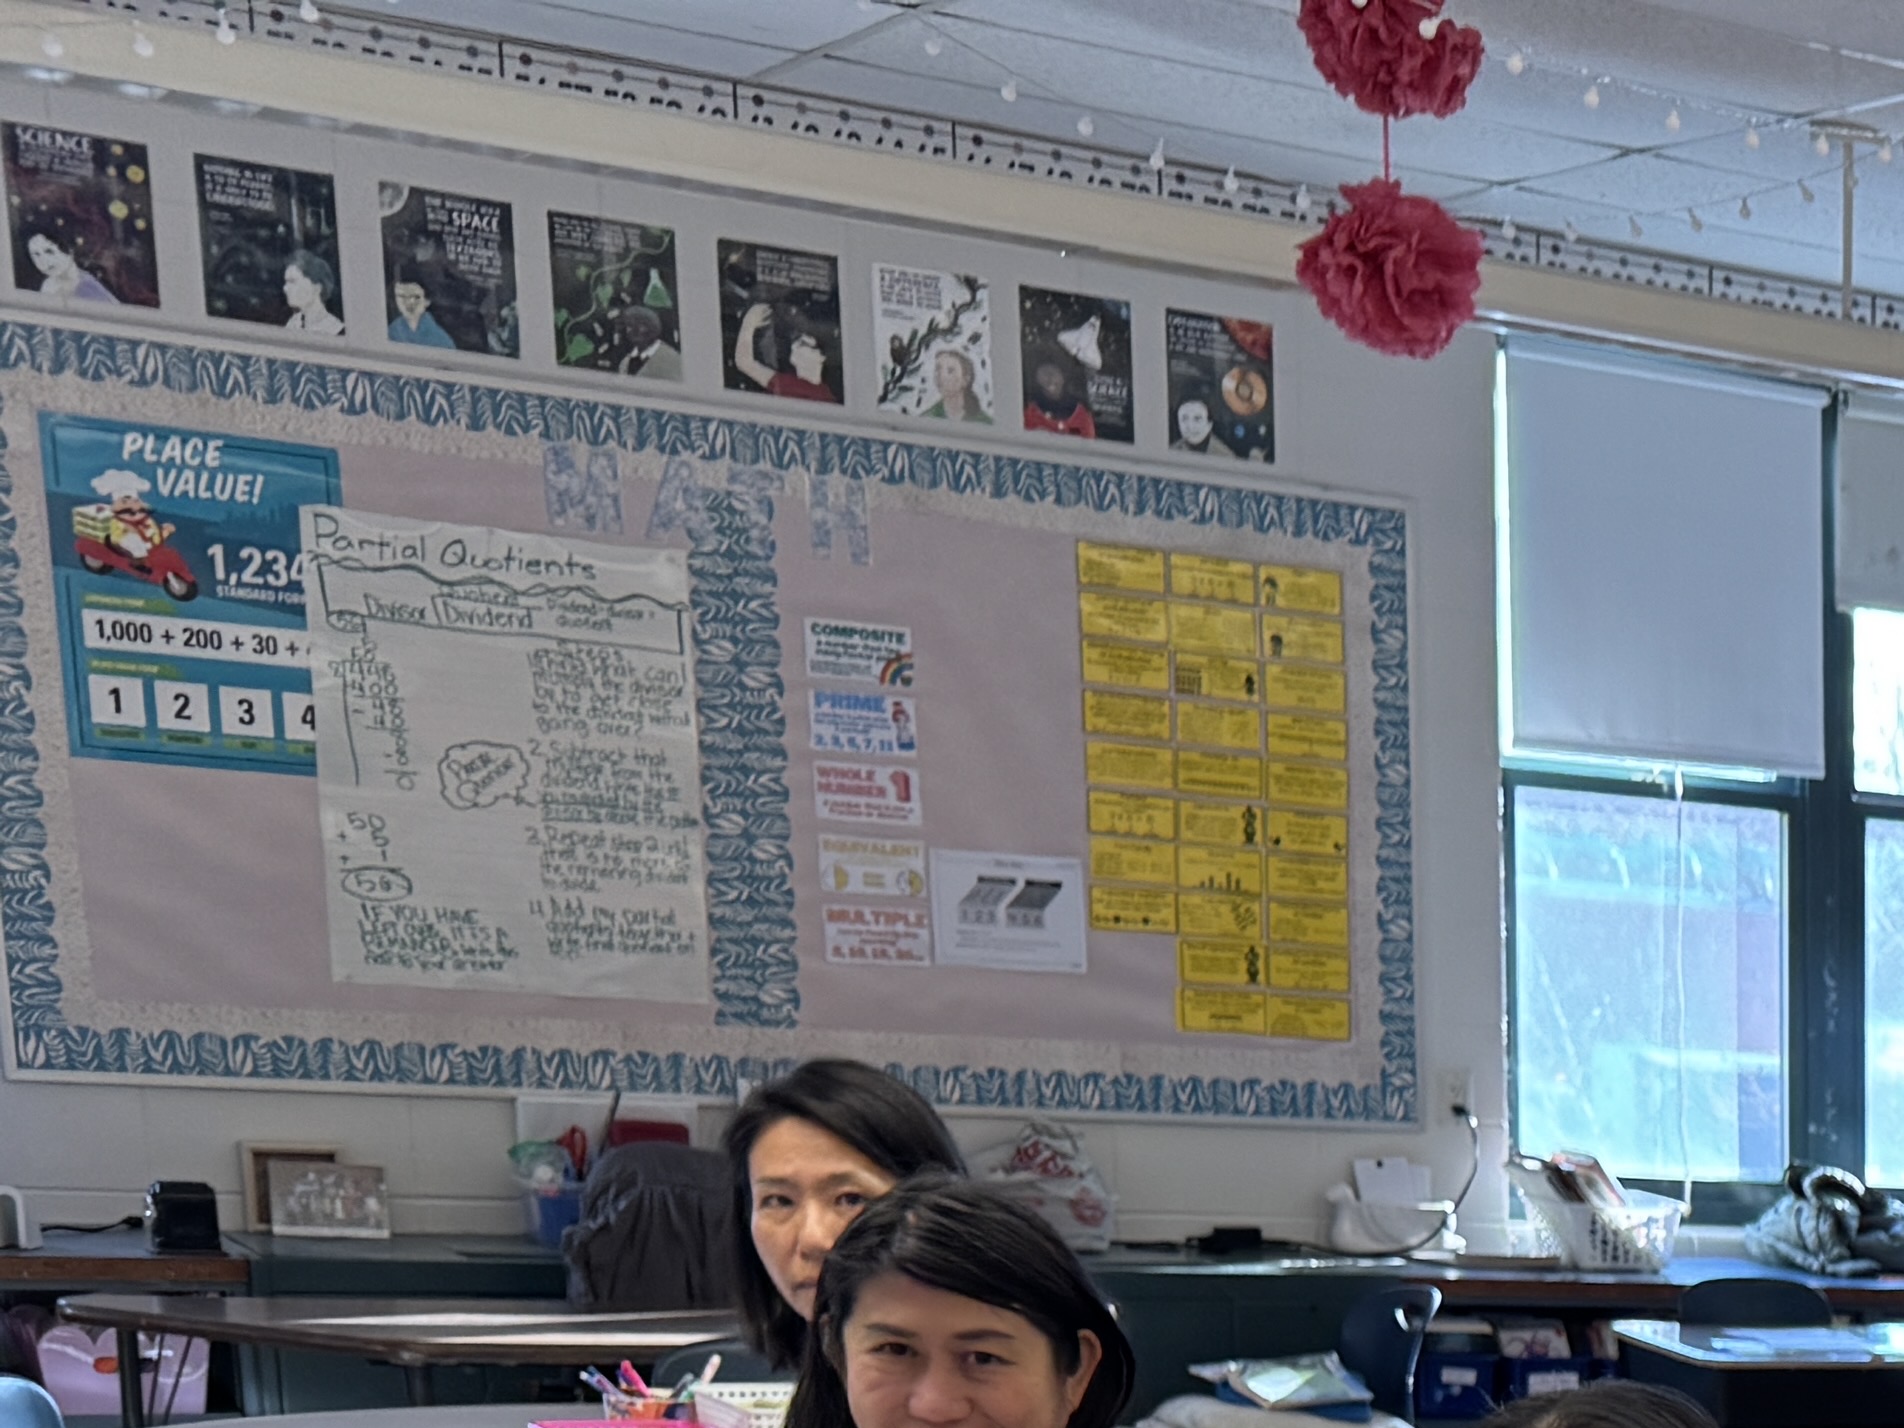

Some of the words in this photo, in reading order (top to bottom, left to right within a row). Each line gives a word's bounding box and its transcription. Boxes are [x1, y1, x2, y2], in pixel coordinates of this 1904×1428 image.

[16, 127, 94, 153] SCIENCE
[452, 211, 500, 232] SPACE
[122, 432, 223, 466] PLACE
[157, 468, 265, 505] VALUE!
[313, 513, 426, 561] Partial
[440, 539, 597, 581] Quotients
[216, 585, 275, 602] STANDARD
[444, 599, 533, 629] Dividend
[95, 619, 152, 644] 1,000
[183, 627, 222, 650] 200
[252, 634, 277, 656] 30
[811, 623, 906, 645] COMPOSITE
[108, 687, 121, 714] 1
[172, 694, 192, 720] 2
[238, 699, 255, 726] 3
[302, 705, 316, 731] 4
[814, 692, 886, 713] PRIME
[816, 766, 876, 783] WHOLE
[817, 782, 886, 799] NUMBER
[361, 903, 385, 921] IF
[390, 904, 428, 922] YOU
